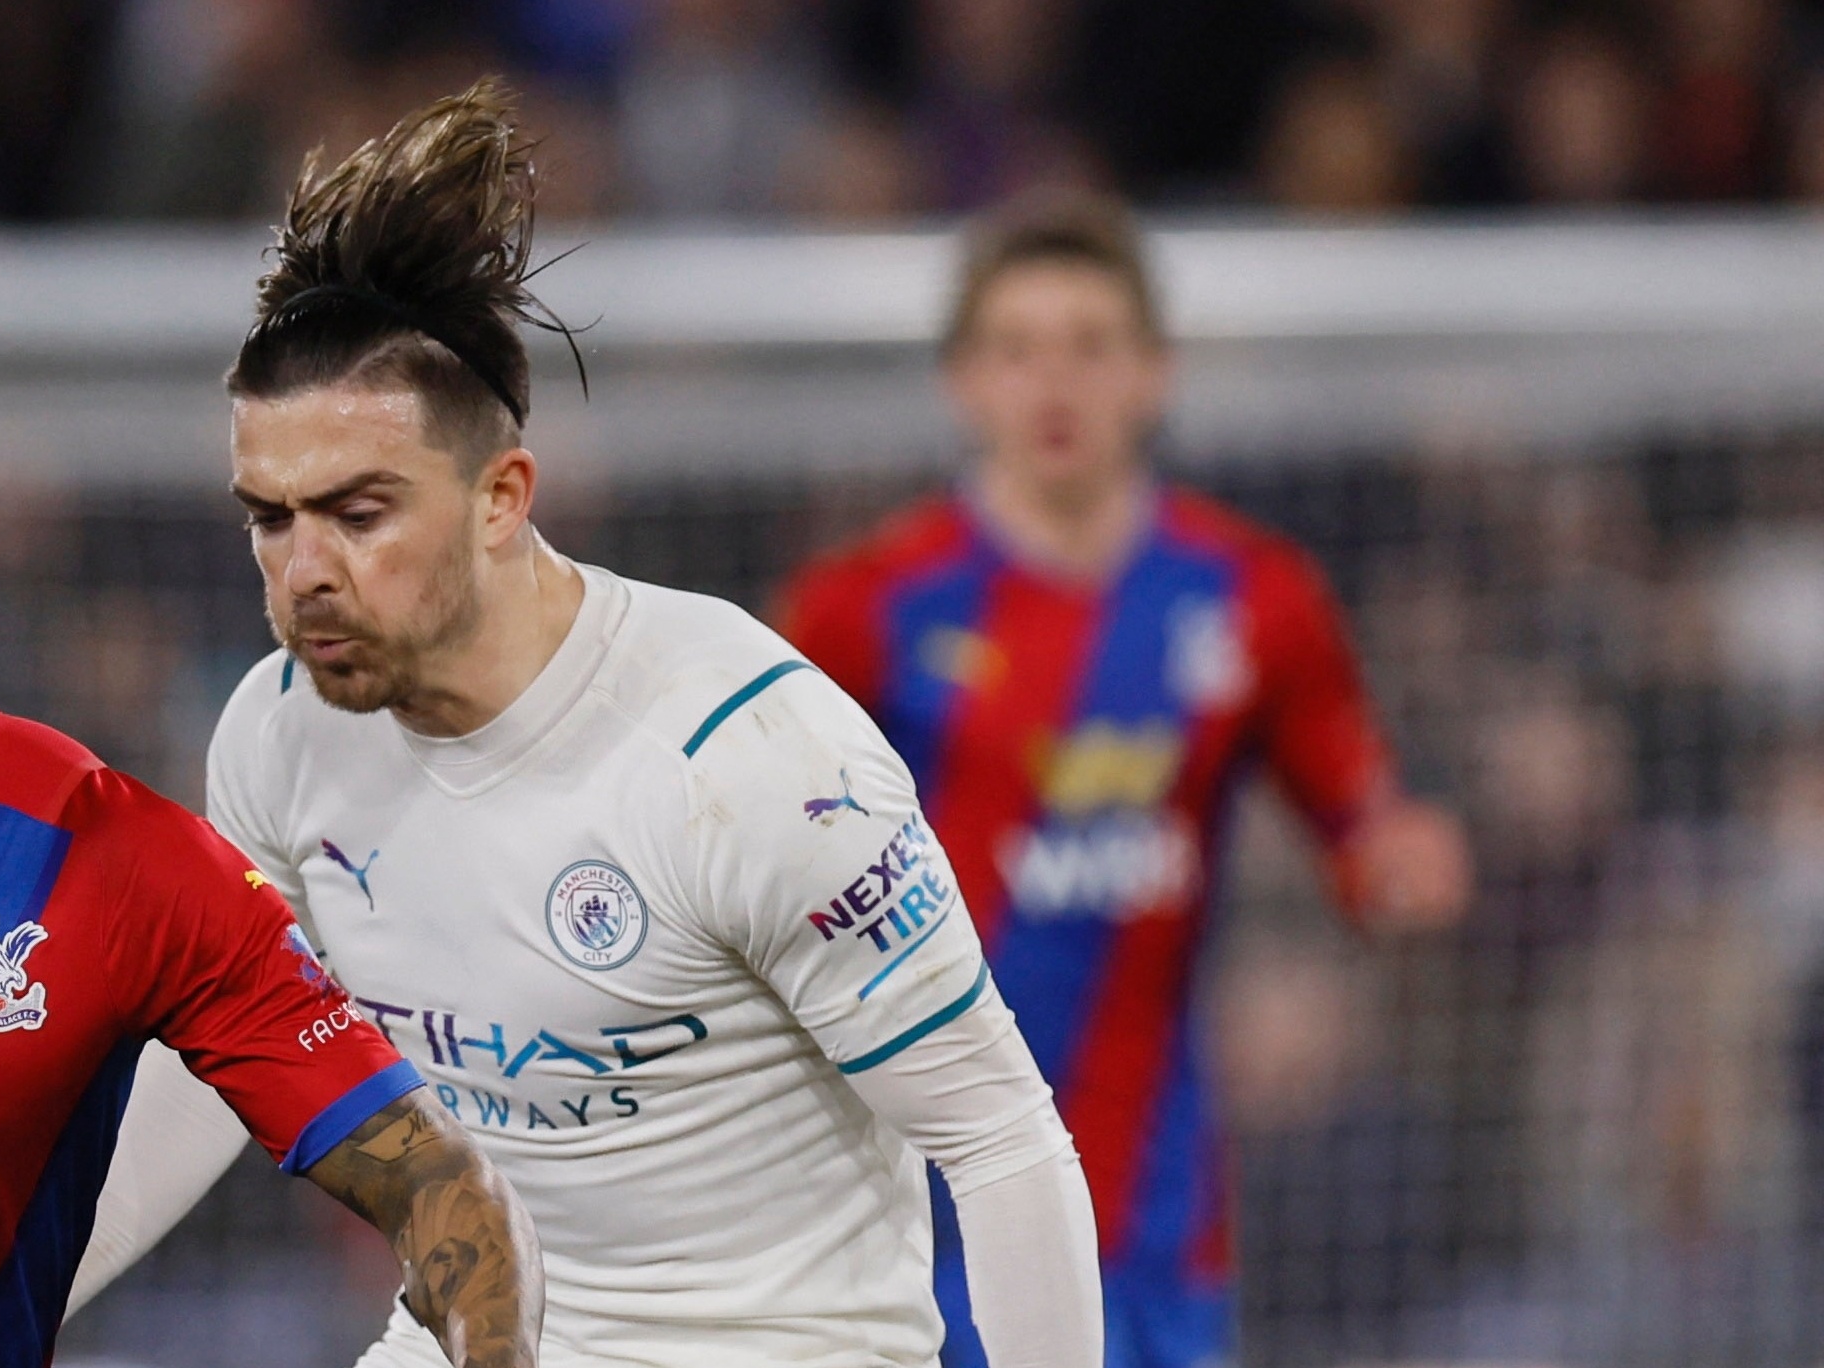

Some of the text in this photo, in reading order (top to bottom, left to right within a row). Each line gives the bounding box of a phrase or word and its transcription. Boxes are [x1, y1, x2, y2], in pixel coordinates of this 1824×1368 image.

[557, 868, 635, 903] MANCHESTER
[856, 861, 950, 953] TIRE
[583, 951, 612, 961] CITY
[355, 996, 709, 1079] TIHAD
[437, 1083, 640, 1130] RWAYS
